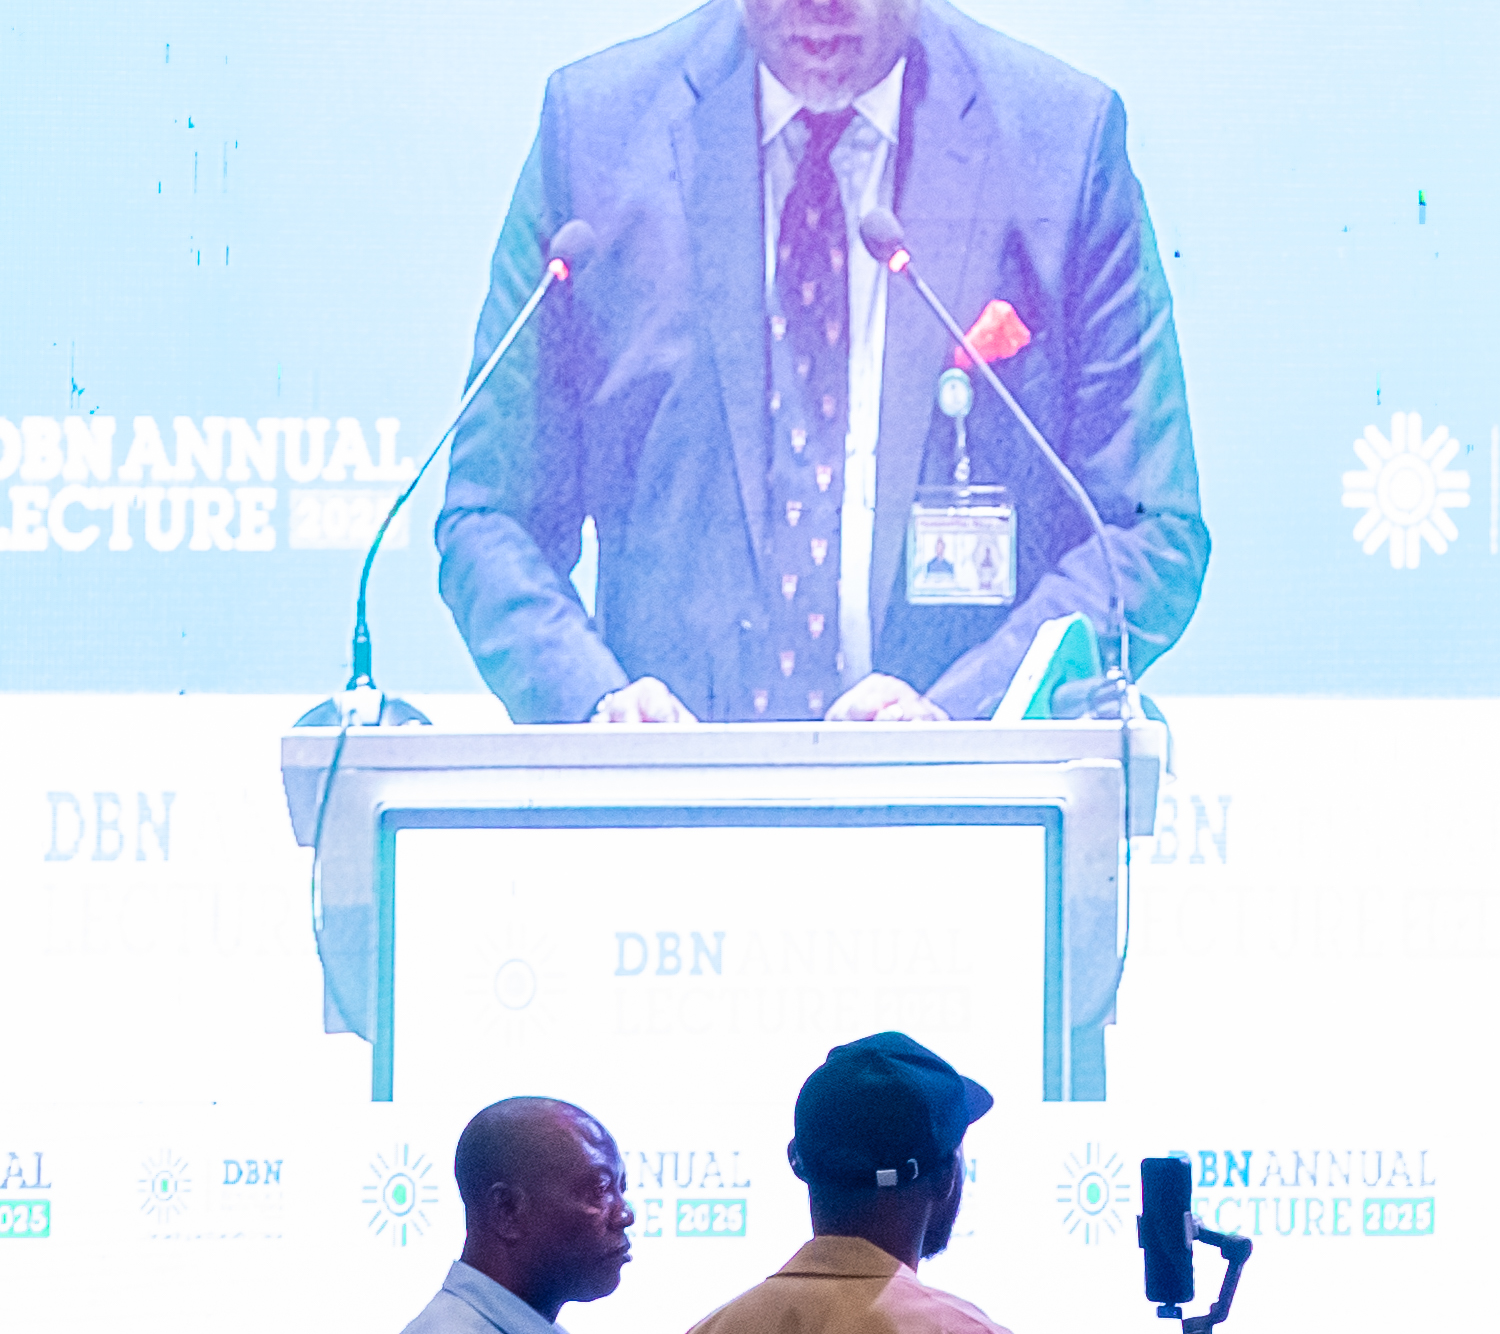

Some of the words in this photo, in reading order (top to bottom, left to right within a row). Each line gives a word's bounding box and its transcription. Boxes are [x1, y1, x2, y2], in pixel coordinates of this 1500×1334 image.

[118, 416, 415, 482] ANNUAL
[0, 485, 278, 552] ECTURE
[44, 790, 178, 861] DBN
[1152, 795, 1233, 863] BN
[615, 931, 727, 975] DBN
[223, 1160, 283, 1185] DBN
[1260, 1151, 1435, 1186] ANNUAL
